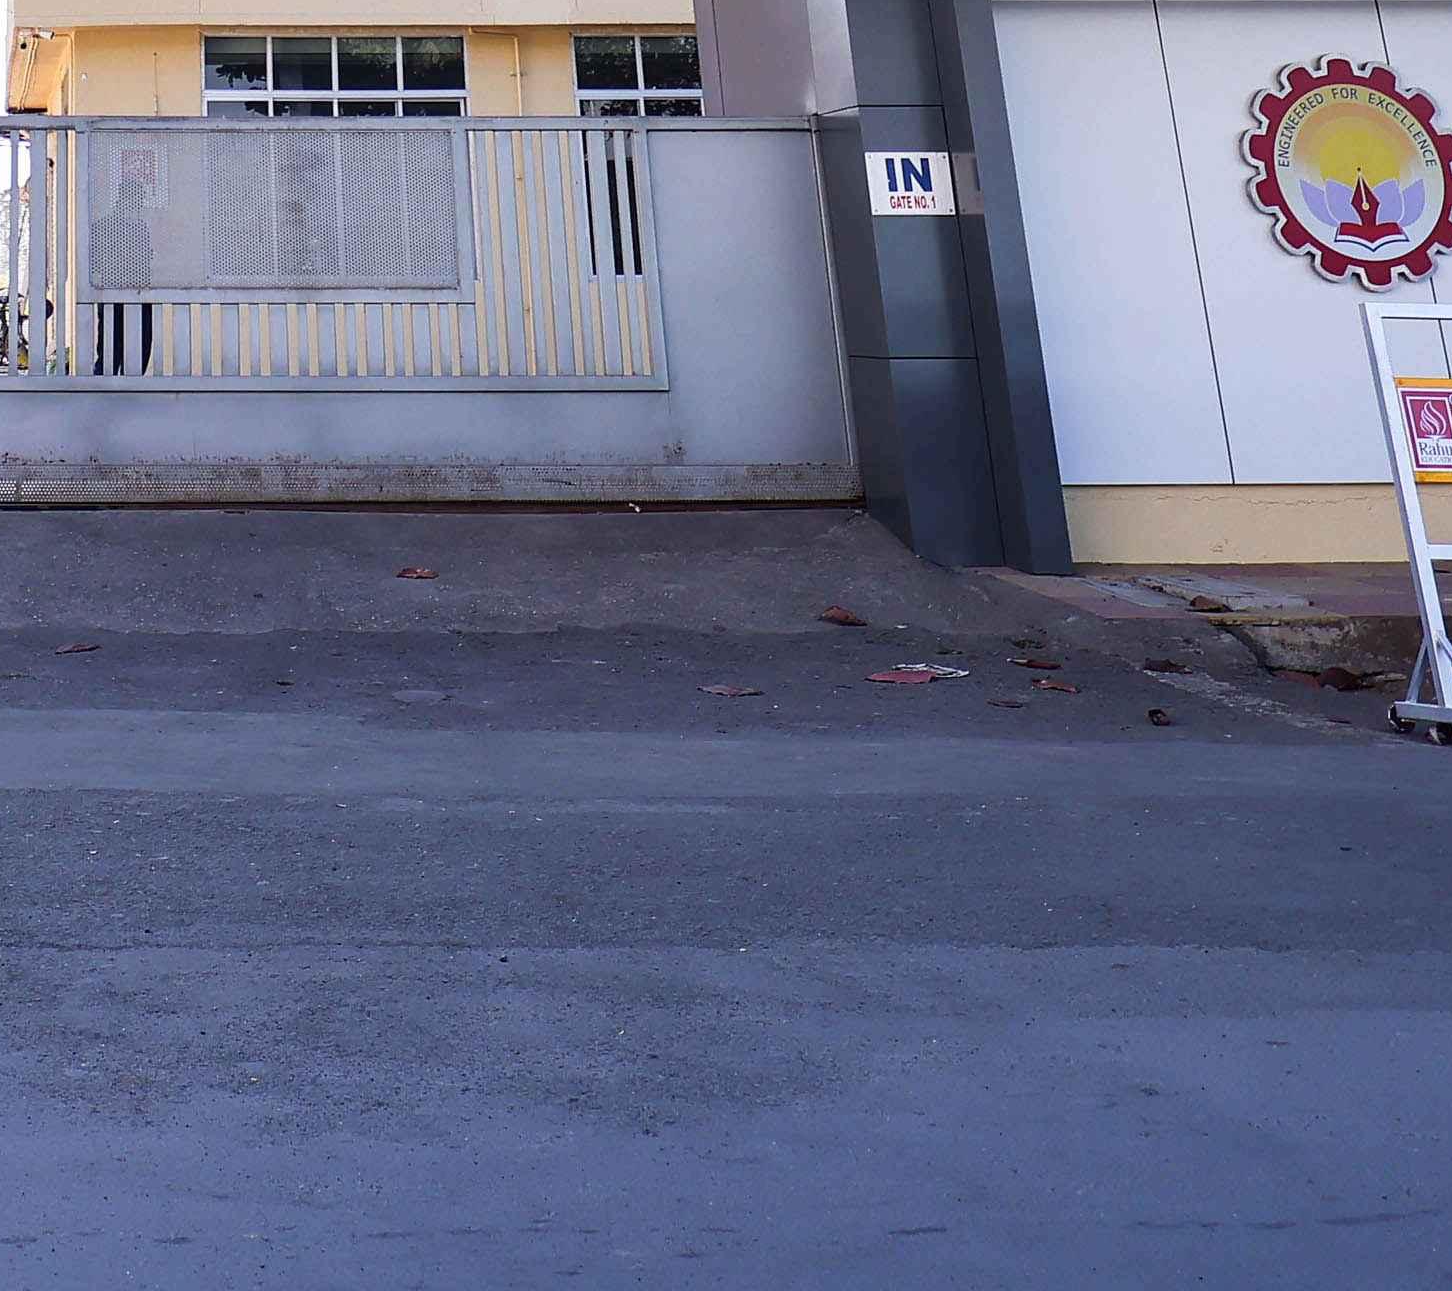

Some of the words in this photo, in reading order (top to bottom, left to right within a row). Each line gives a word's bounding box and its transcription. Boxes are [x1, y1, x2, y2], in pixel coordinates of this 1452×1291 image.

[1277, 92, 1325, 168] ENGINEERED
[1331, 87, 1359, 101] FOR
[1367, 93, 1438, 168] EXCELLENCE
[884, 157, 933, 192] IN
[890, 196, 913, 209] GATE
[914, 196, 930, 209] NO.
